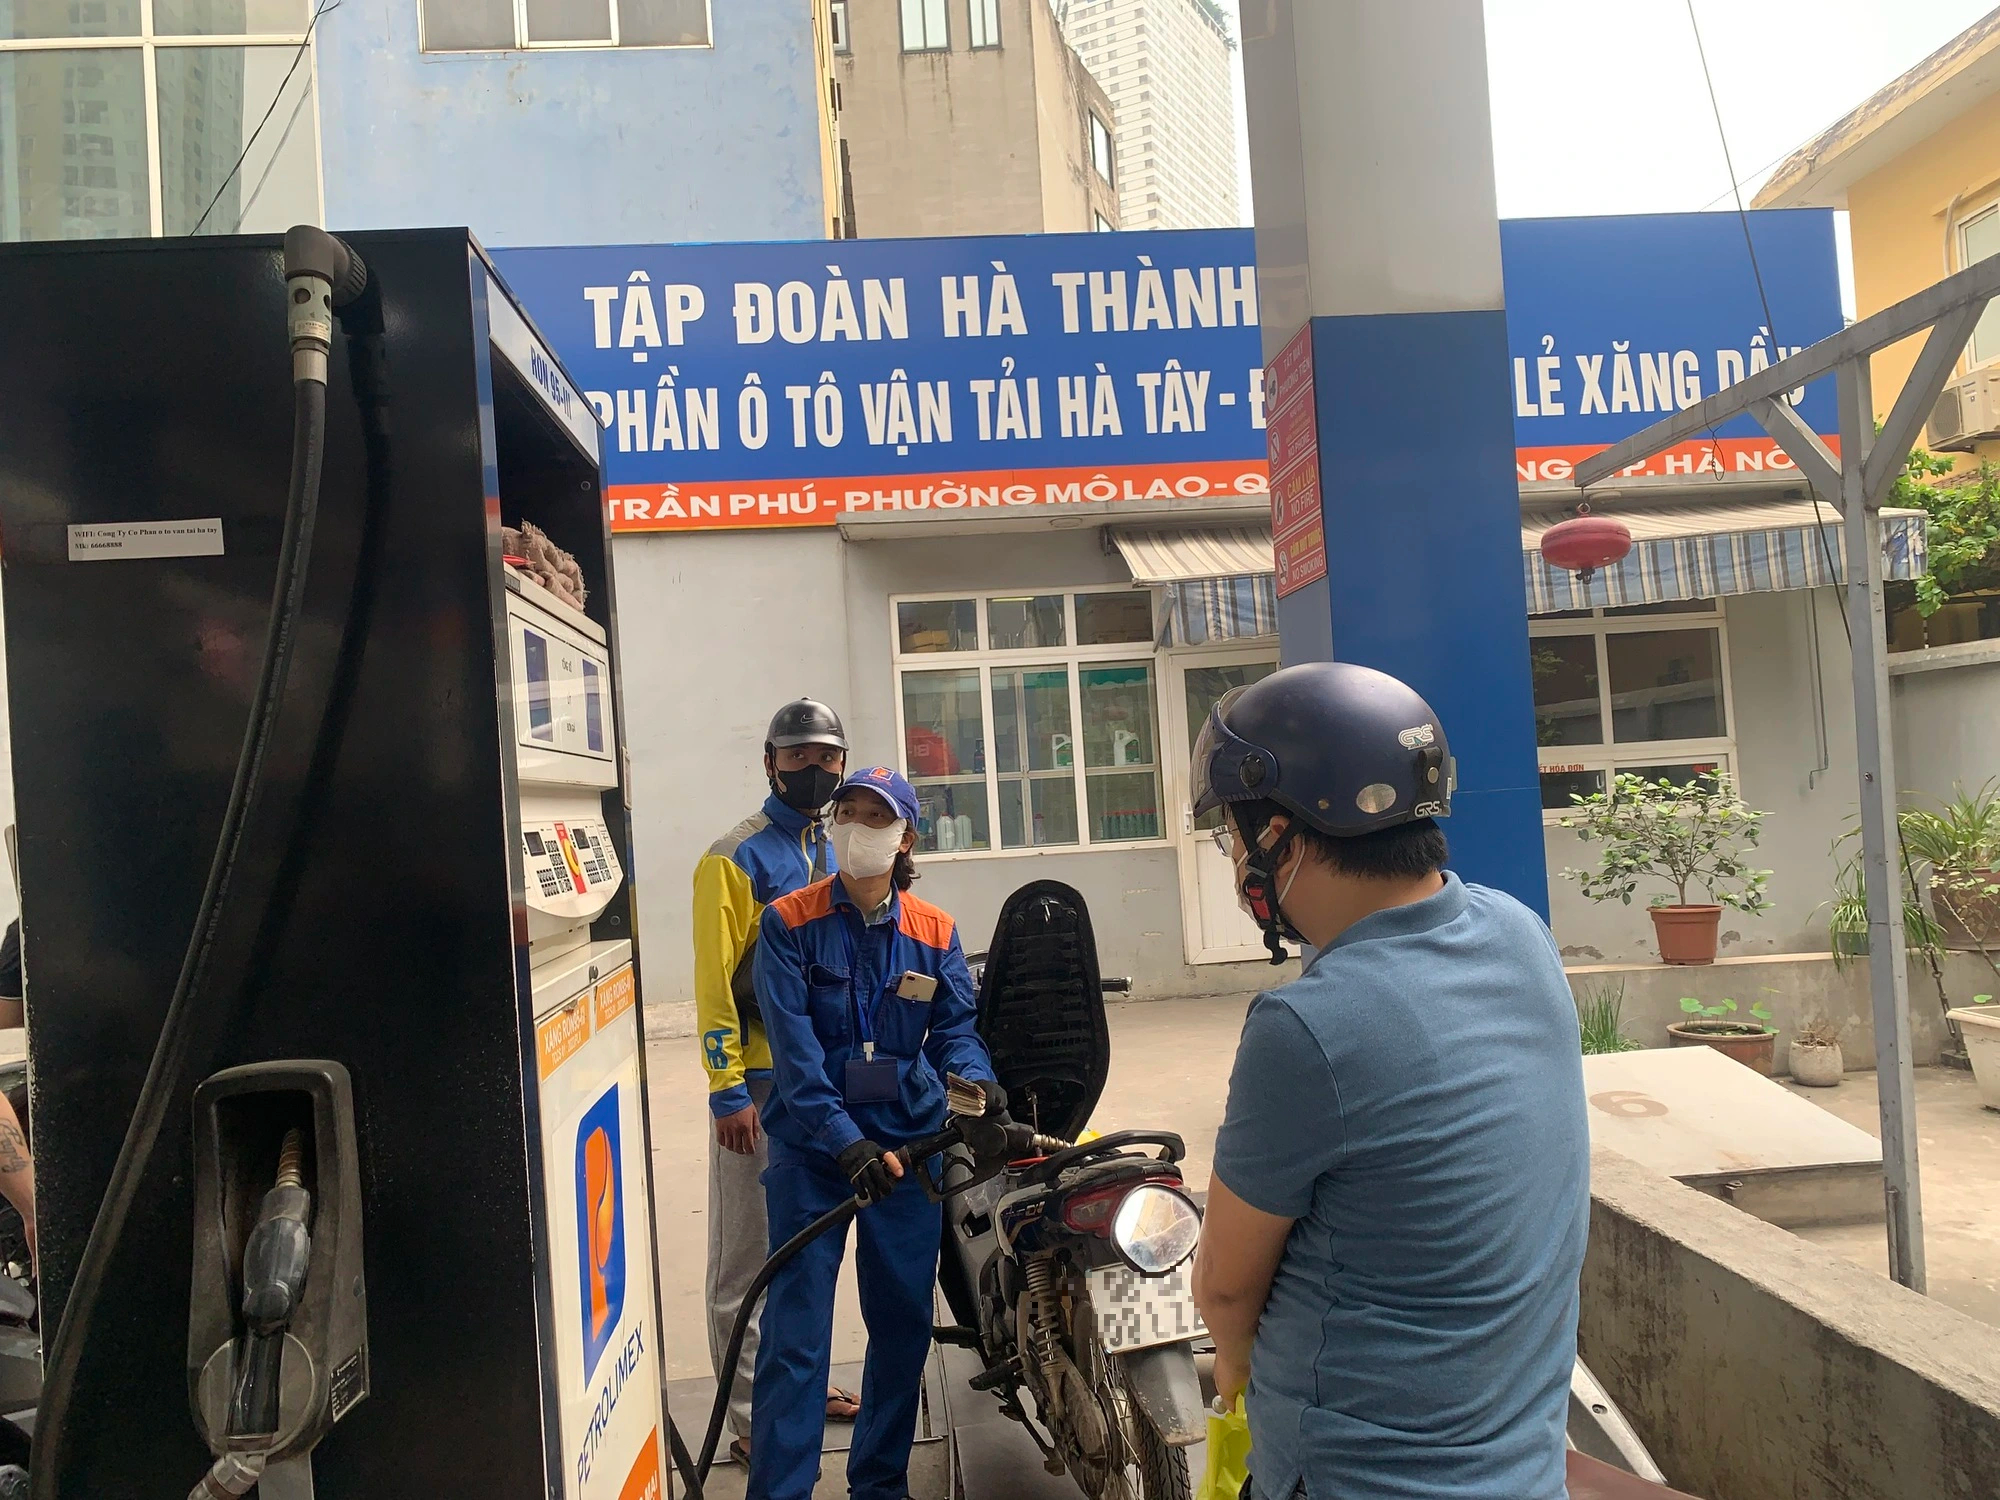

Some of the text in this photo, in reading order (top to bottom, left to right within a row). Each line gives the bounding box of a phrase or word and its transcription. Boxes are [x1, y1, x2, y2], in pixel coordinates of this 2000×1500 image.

[584, 255, 1260, 362] TẬP ĐOÀN HÀ THÀNH
[530, 344, 549, 393] RON
[1514, 335, 1566, 417] LẺ
[1576, 340, 1702, 415] XĂNG
[584, 366, 720, 452] PHẦN
[737, 372, 769, 450] Ô
[785, 371, 843, 448] TÔ
[860, 368, 952, 456] VẬN
[970, 357, 1042, 440] TẢI
[1058, 363, 1123, 437] HÀ
[1136, 359, 1211, 435] TÂY
[1516, 458, 1573, 481] NG
[1608, 460, 1654, 478] P.
[1665, 447, 1726, 474] HÀ
[609, 483, 720, 521] TRẦN
[729, 482, 817, 515] PHÚ
[845, 479, 1037, 512] PHƯỜNG
[1290, 487, 1314, 517] NO FIRE
[97, 530, 116, 538] Cong
[118, 529, 126, 538] Ty
[207, 527, 217, 535] tay
[1292, 552, 1323, 582] NO SMOKING
[1399, 725, 1434, 746] GRS
[1414, 800, 1442, 818] GRS
[577, 1319, 645, 1500] PETROLIMEX
